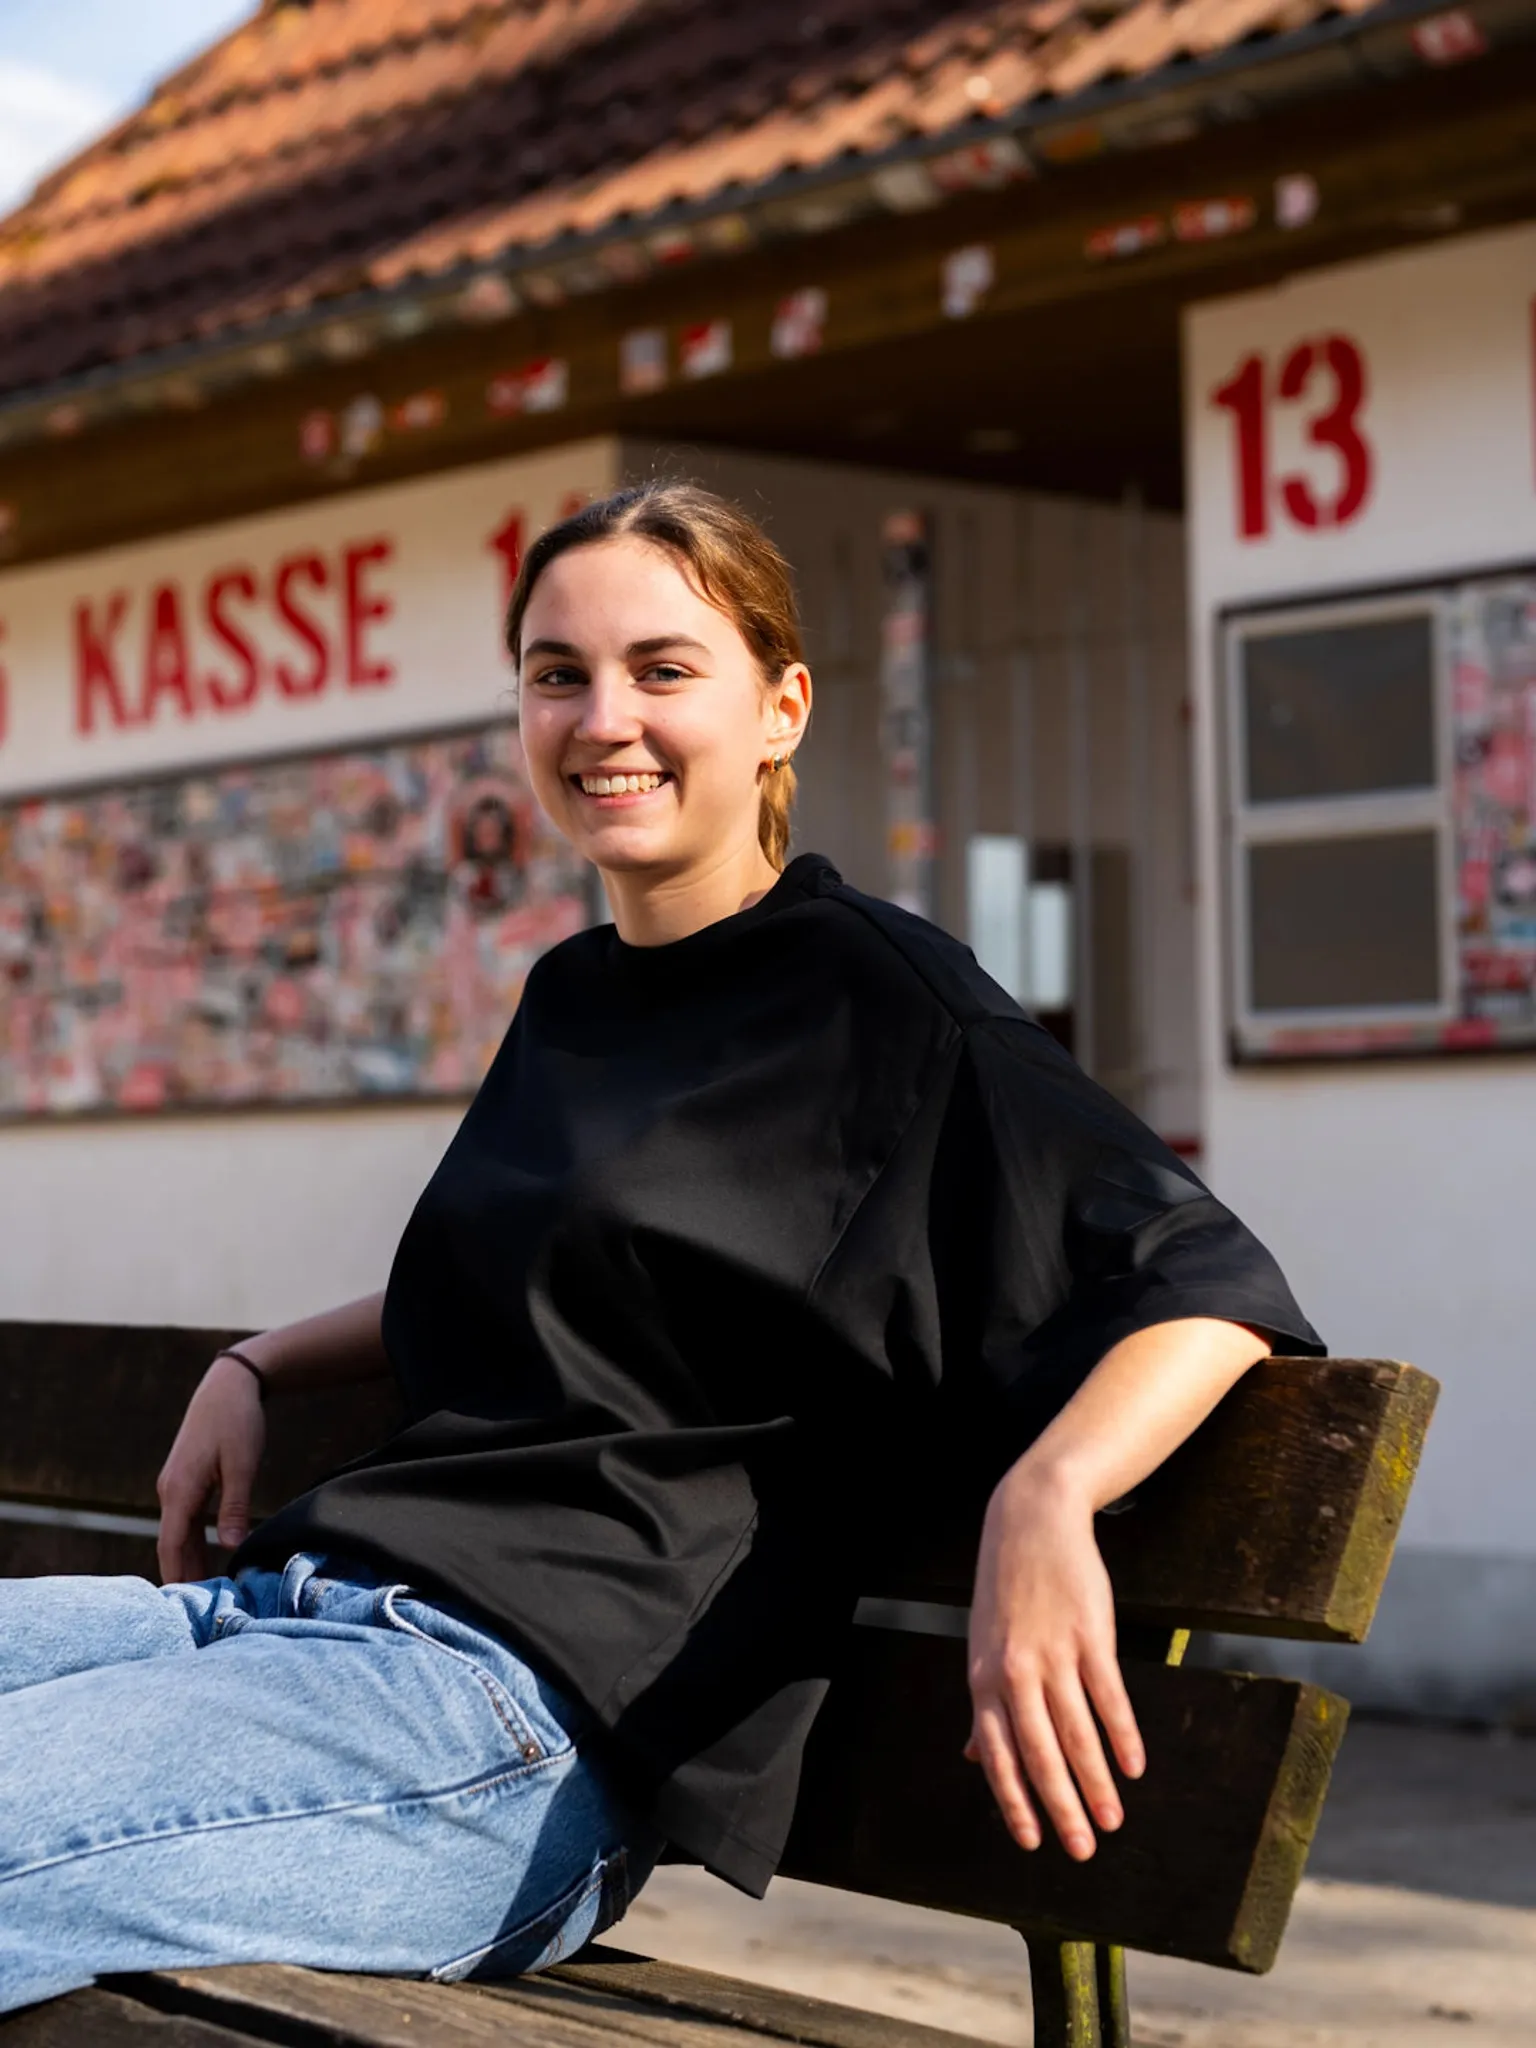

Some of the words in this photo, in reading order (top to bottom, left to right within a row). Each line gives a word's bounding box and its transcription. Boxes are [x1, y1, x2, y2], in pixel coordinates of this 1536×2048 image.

[1210, 332, 1375, 542] 13
[74, 538, 395, 736] KASSE
[484, 491, 594, 662] 1
